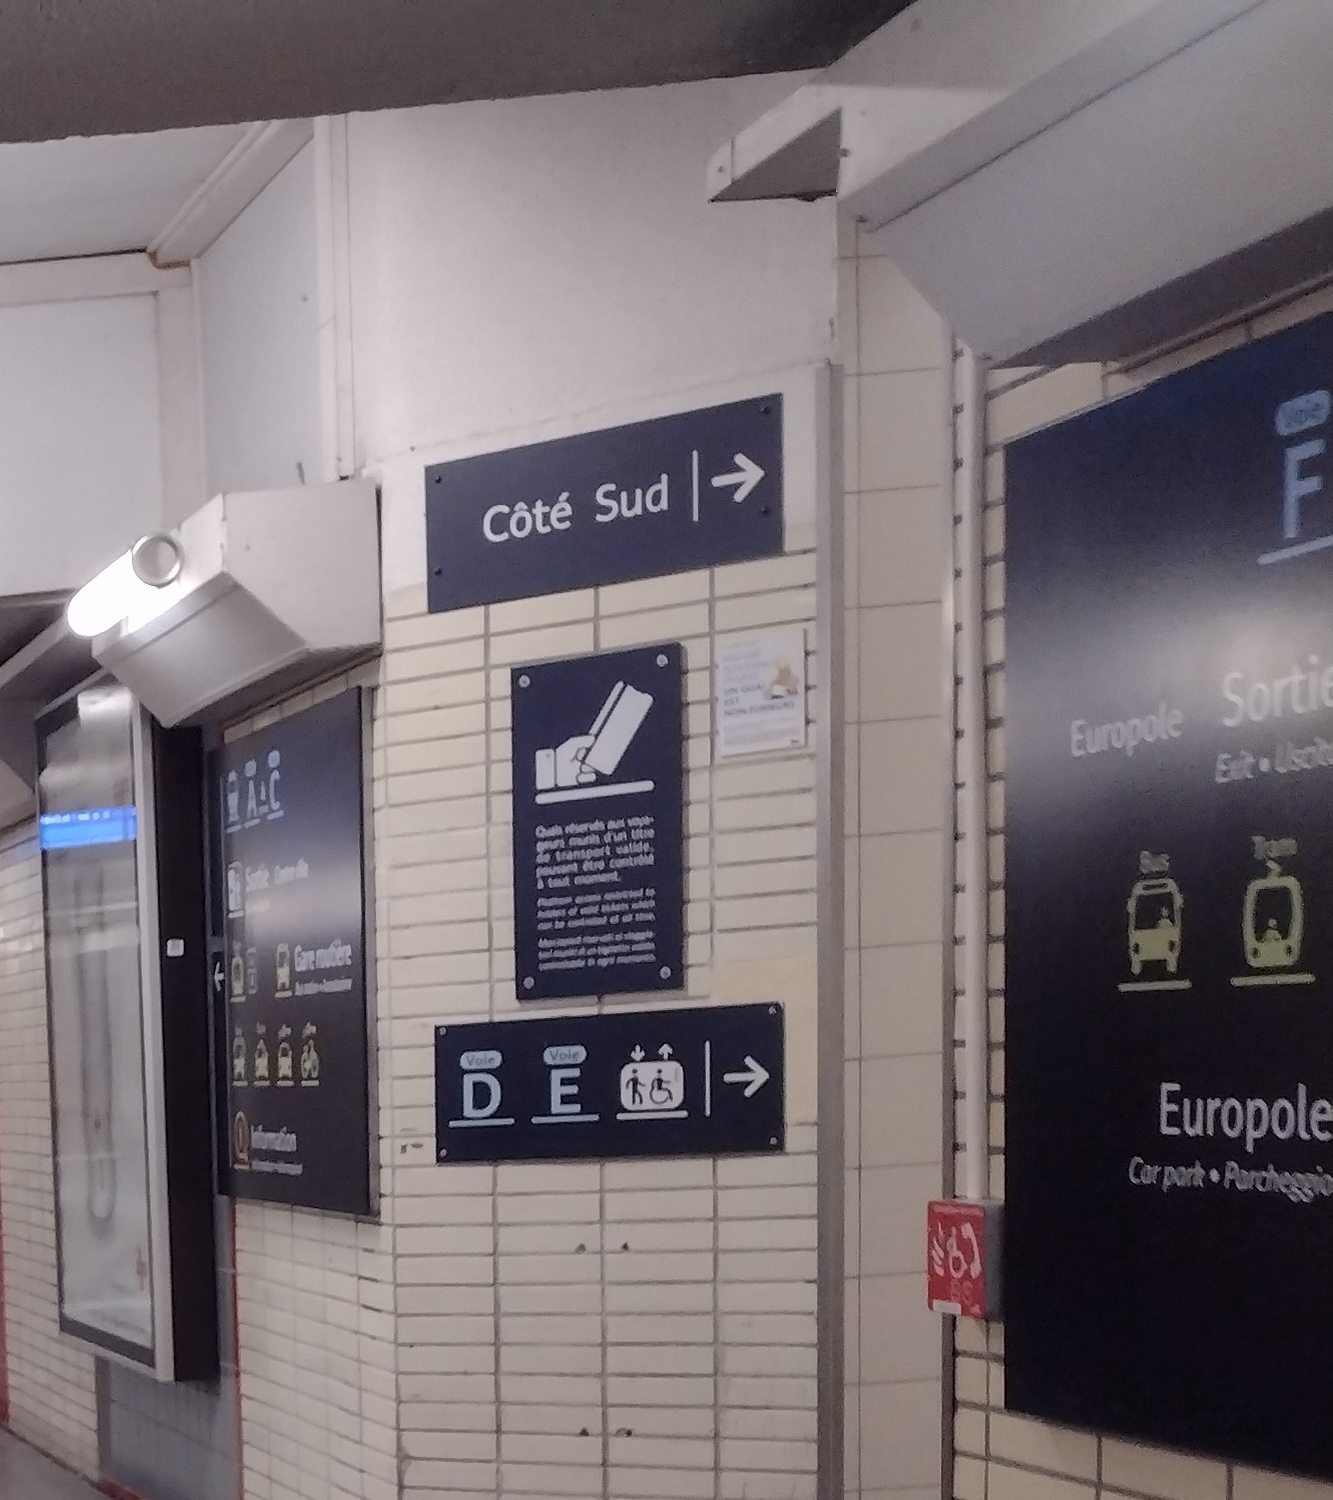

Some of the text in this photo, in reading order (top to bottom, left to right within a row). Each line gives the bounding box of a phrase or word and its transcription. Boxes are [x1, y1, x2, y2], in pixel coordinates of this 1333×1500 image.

[482, 473, 670, 543] Côté Sud
[1283, 438, 1326, 539] F
[1221, 653, 1333, 728] Sortie
[1071, 701, 1185, 757] Europole
[462, 1067, 582, 1119] D E
[1159, 1080, 1333, 1155] Europole
